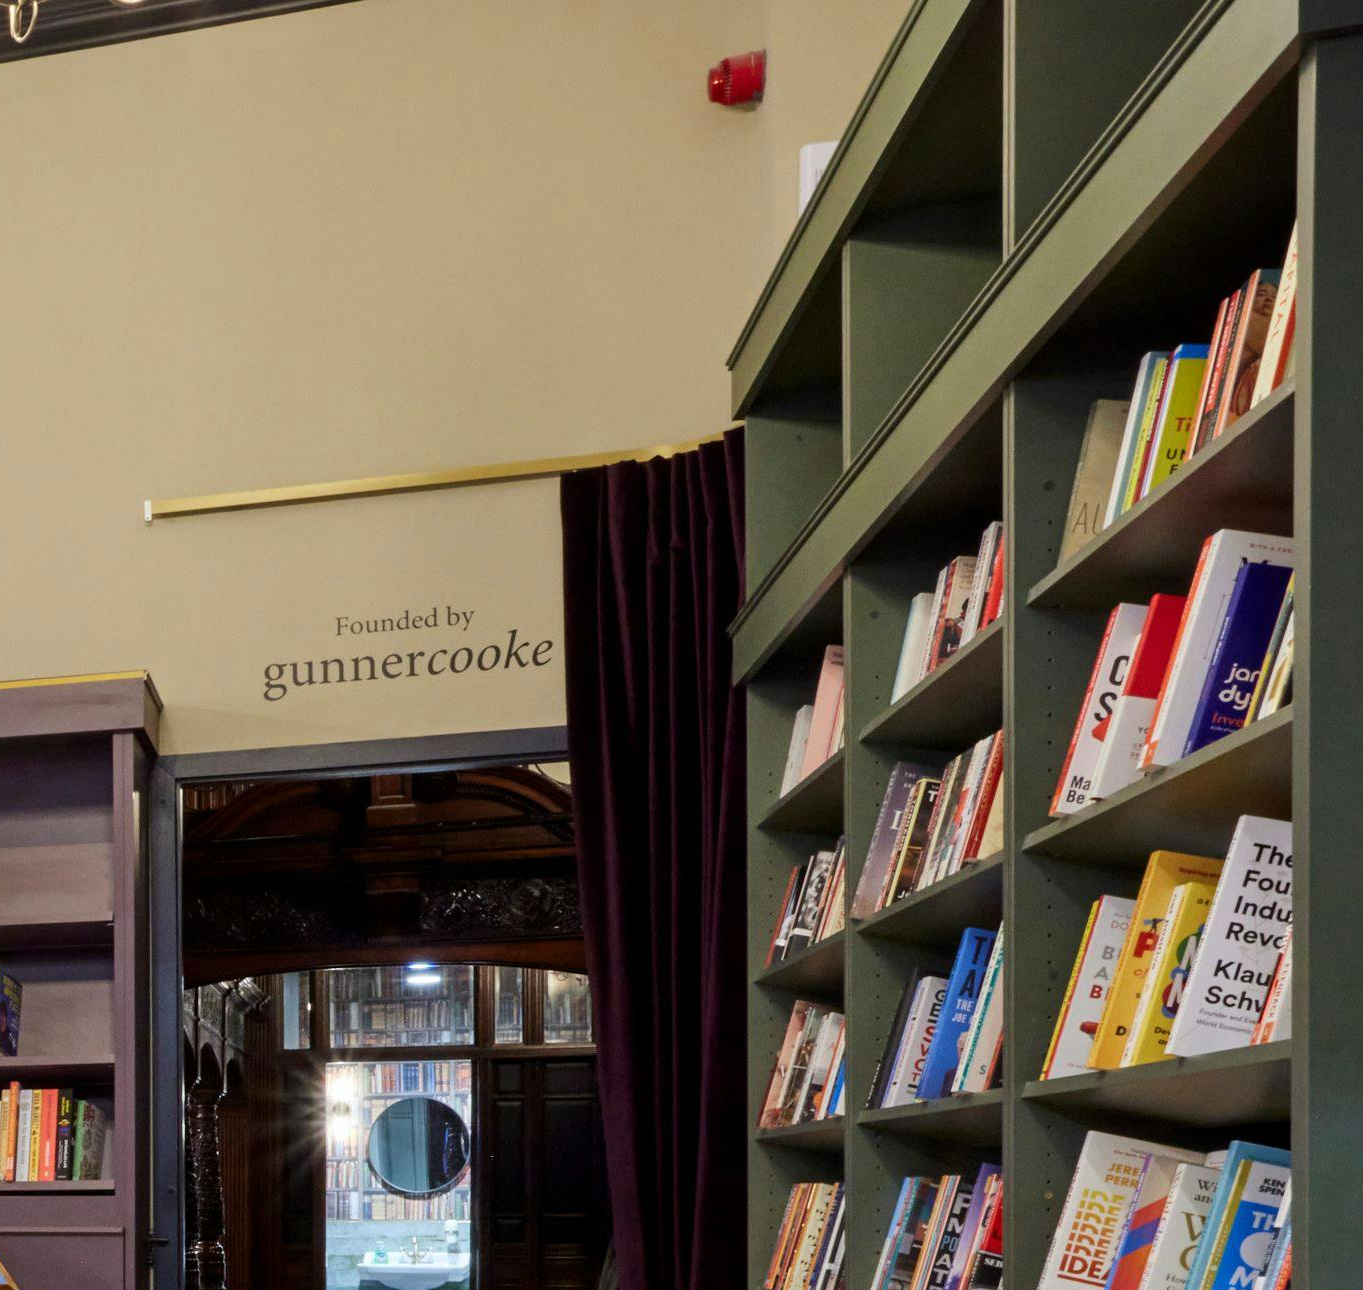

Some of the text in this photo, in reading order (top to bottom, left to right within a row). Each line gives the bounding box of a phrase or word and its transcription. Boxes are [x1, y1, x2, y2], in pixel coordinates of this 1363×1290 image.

[335, 606, 474, 636] Founded by
[263, 629, 553, 701] gunnercooke
[1214, 961, 1272, 987] Klau
